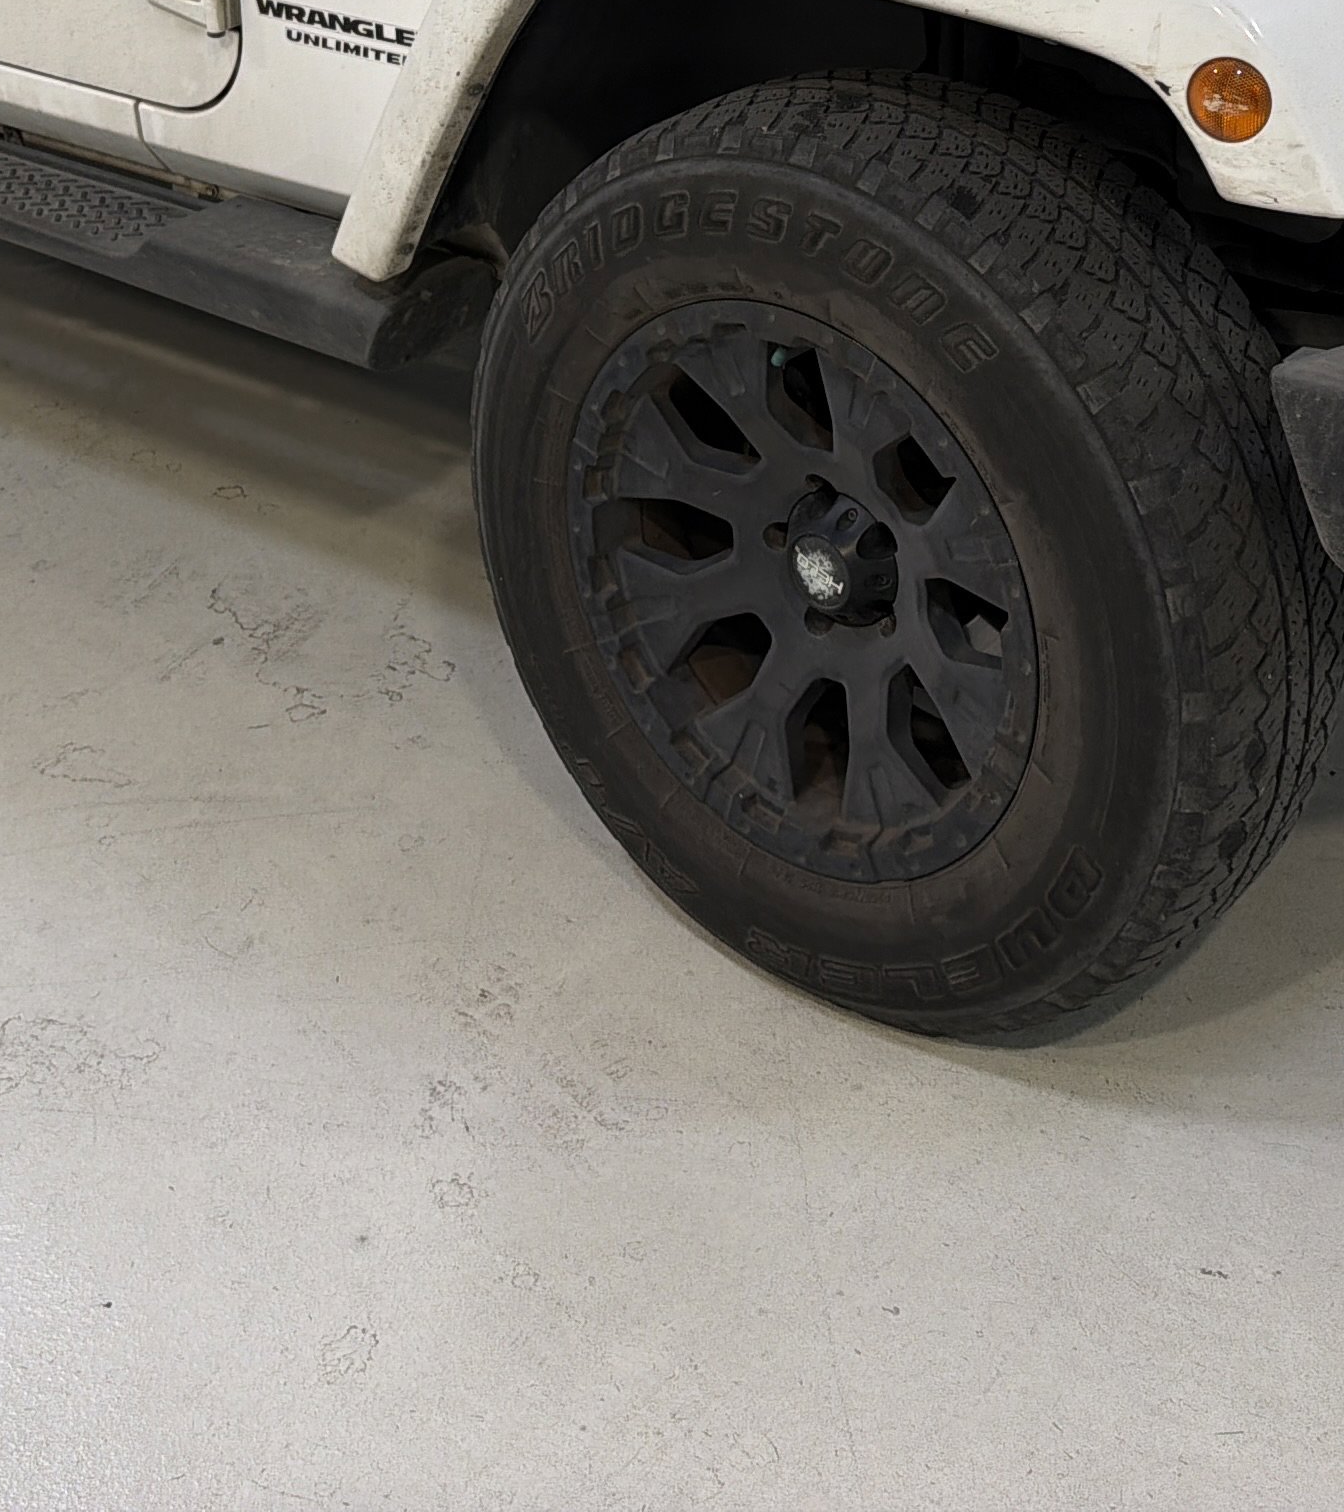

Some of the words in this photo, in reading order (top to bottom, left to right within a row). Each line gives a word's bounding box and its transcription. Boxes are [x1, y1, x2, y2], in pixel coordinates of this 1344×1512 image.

[286, 29, 408, 66] UNLIMITE
[518, 190, 1001, 374] BRIDGESTONE
[742, 843, 1104, 1000] DUELER
